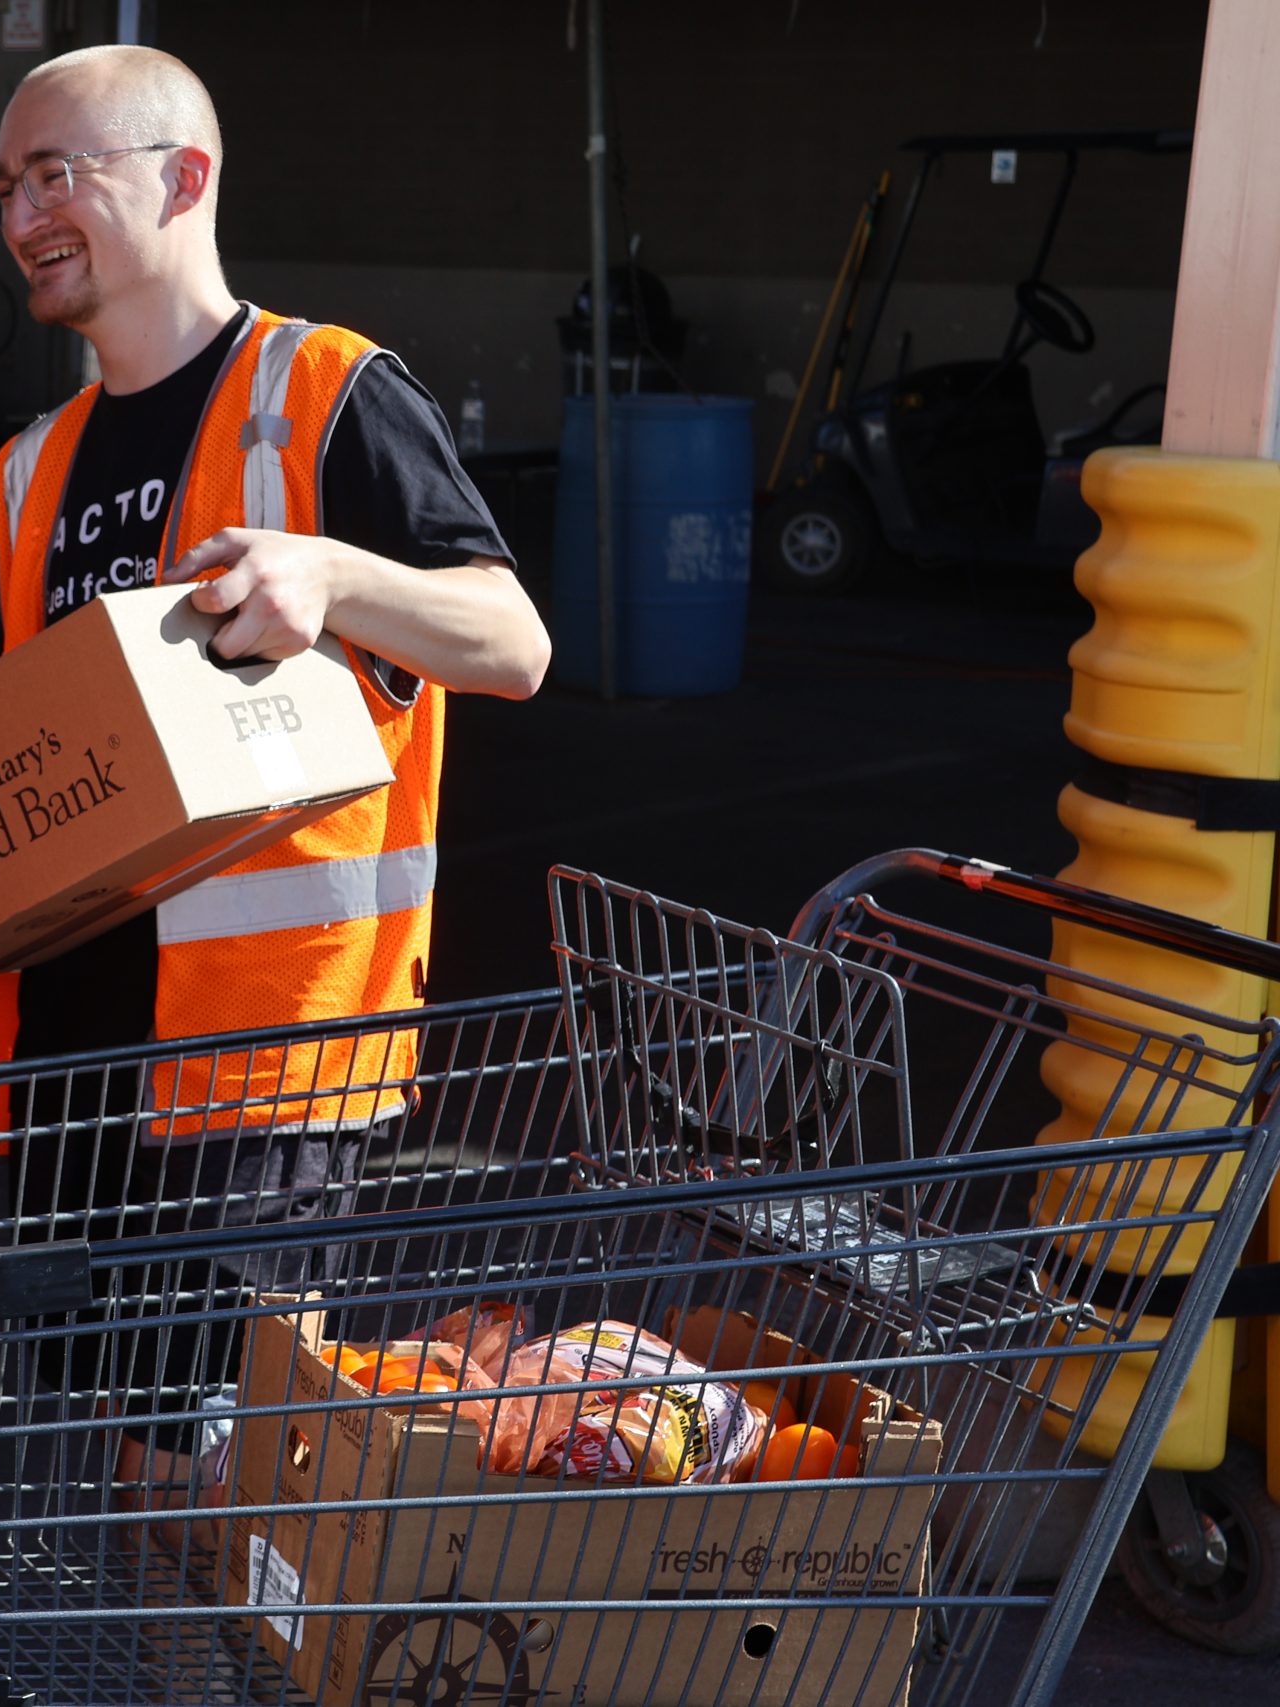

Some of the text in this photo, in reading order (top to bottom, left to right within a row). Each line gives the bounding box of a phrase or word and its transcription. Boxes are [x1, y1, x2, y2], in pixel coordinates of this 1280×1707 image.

[224, 694, 303, 742] EFB
[11, 747, 126, 843] Bank
[446, 1532, 467, 1554] N
